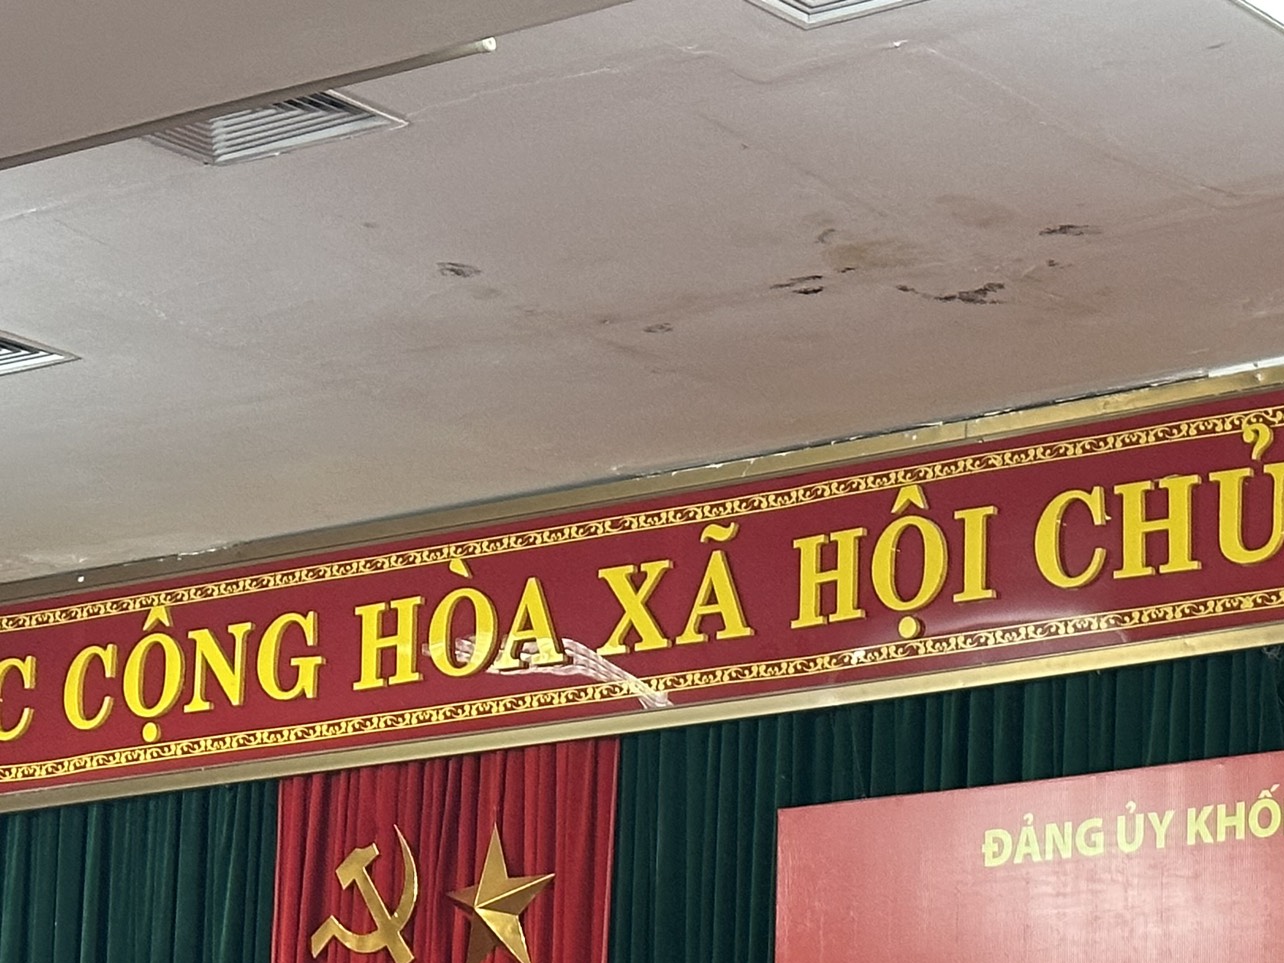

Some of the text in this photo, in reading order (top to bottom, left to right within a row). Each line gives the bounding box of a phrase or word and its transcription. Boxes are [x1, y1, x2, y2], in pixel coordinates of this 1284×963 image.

[63, 606, 324, 743] CỘNG
[353, 560, 566, 691] HÒA
[598, 522, 753, 657] XÃ
[790, 485, 998, 639] HỘI
[981, 813, 1105, 868] ĐẢNG
[1116, 801, 1174, 854] ỦY
